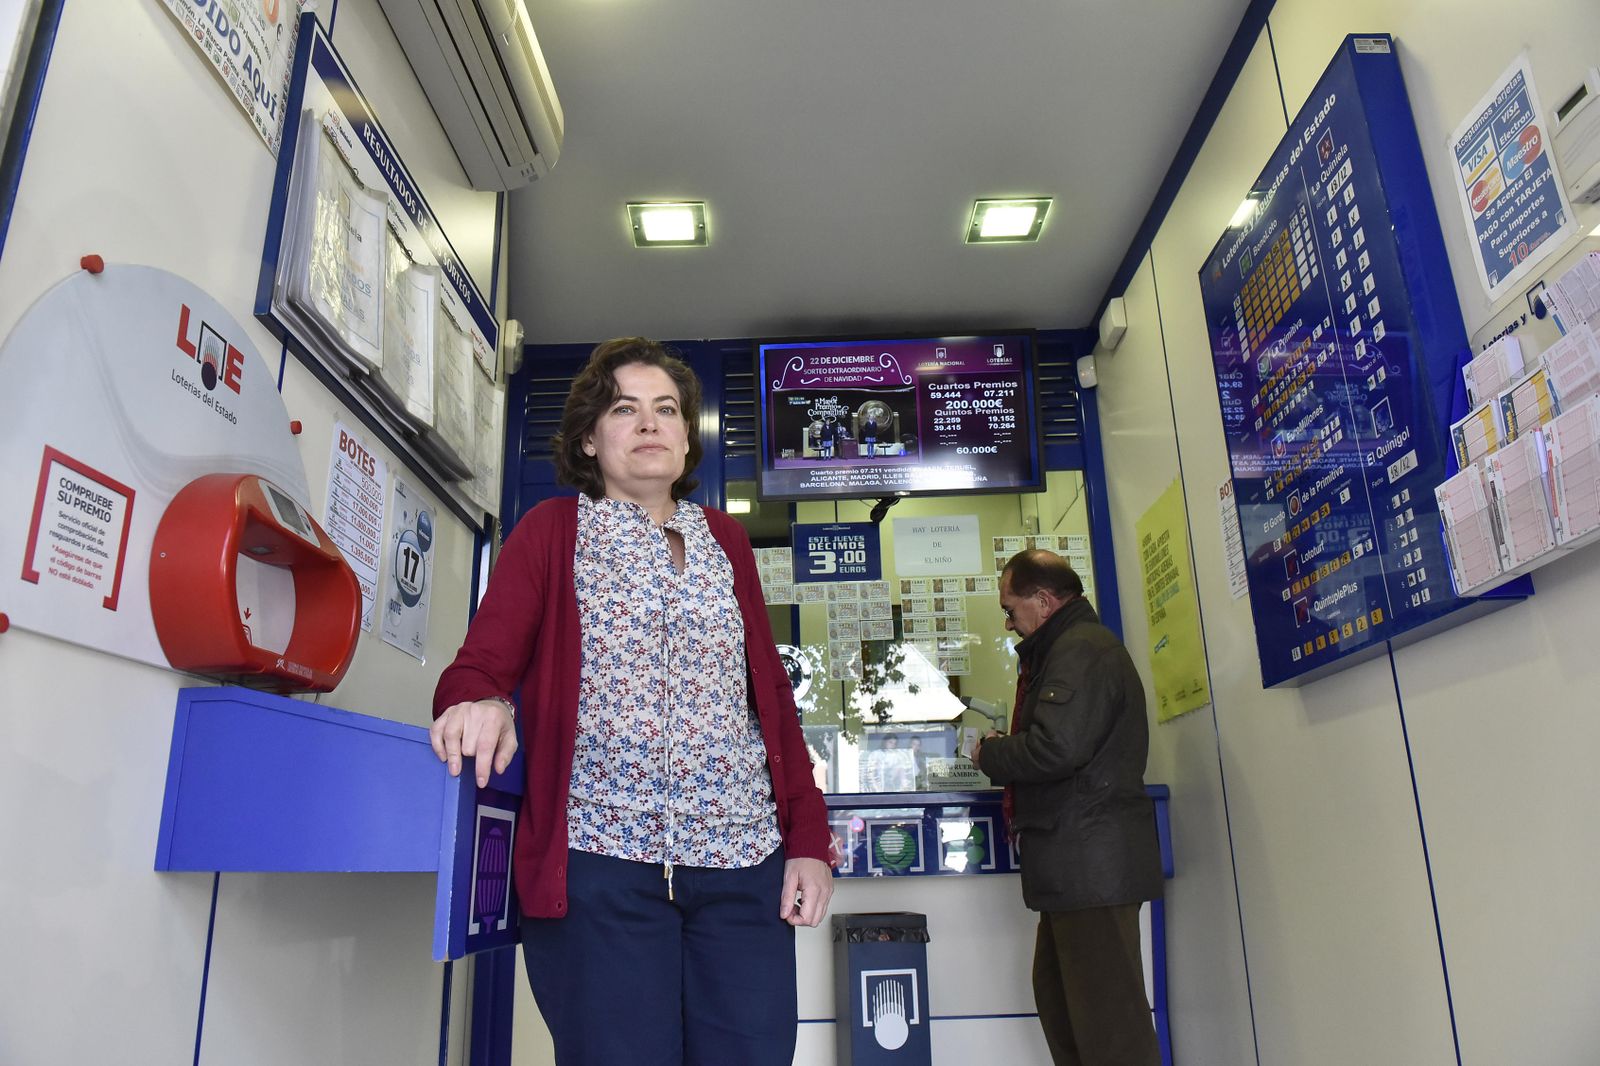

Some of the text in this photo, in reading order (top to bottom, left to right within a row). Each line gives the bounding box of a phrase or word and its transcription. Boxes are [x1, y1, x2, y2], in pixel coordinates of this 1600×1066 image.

[1456, 74, 1522, 153] Aceptamos Tarjetas
[1501, 101, 1520, 124] VISA
[1500, 111, 1531, 146] Electron
[1255, 163, 1290, 221] Apuestas
[1290, 140, 1304, 166] del
[1304, 94, 1336, 144] Estado
[1467, 144, 1488, 172] VISA
[1506, 136, 1538, 172] Maestro
[1312, 144, 1348, 196] La Quiniela
[1478, 168, 1553, 244] PAGO con TARJETA
[1486, 168, 1534, 220] Se Acepta El
[364, 122, 416, 214] RESULTADOS
[443, 253, 471, 304] SORTEOS
[1490, 194, 1545, 249] Para Importes
[1252, 220, 1278, 257] BonoLoto
[1498, 210, 1548, 258] Superiores a
[1509, 242, 1528, 268] 10
[1278, 318, 1302, 347] Primitiva
[1520, 314, 1526, 326] y
[820, 356, 831, 364] DE
[832, 354, 876, 364] DICIEMBRE
[828, 366, 882, 374] EXTRAORDINARIO
[171, 368, 238, 425] Loterías del Estado
[928, 381, 1018, 390] Cuartos Premios
[934, 407, 1015, 416] Quintos Premios
[946, 398, 1003, 409] 200.000€
[1286, 404, 1324, 444] EuroMillones
[339, 429, 376, 478] BOTES
[956, 446, 998, 454] 60.000€
[1366, 426, 1410, 466] El Quinigol
[57, 490, 112, 523] SU PREMIO
[60, 478, 113, 510] COMPRUEBE
[1263, 466, 1344, 533] El Gordo de la Primitiva
[58, 510, 106, 536] Servicio oficial de
[58, 523, 104, 546] comprobación de
[49, 530, 82, 548] resguardos
[86, 544, 109, 559] décimos.
[1300, 540, 1324, 564] Lototurf
[48, 567, 58, 576] NO
[56, 558, 76, 571] código
[76, 564, 84, 573] de
[84, 570, 102, 581] barras
[84, 558, 92, 566] de
[92, 562, 103, 570] que
[403, 546, 420, 584] 17
[1314, 582, 1358, 612] QuintuplePlus
